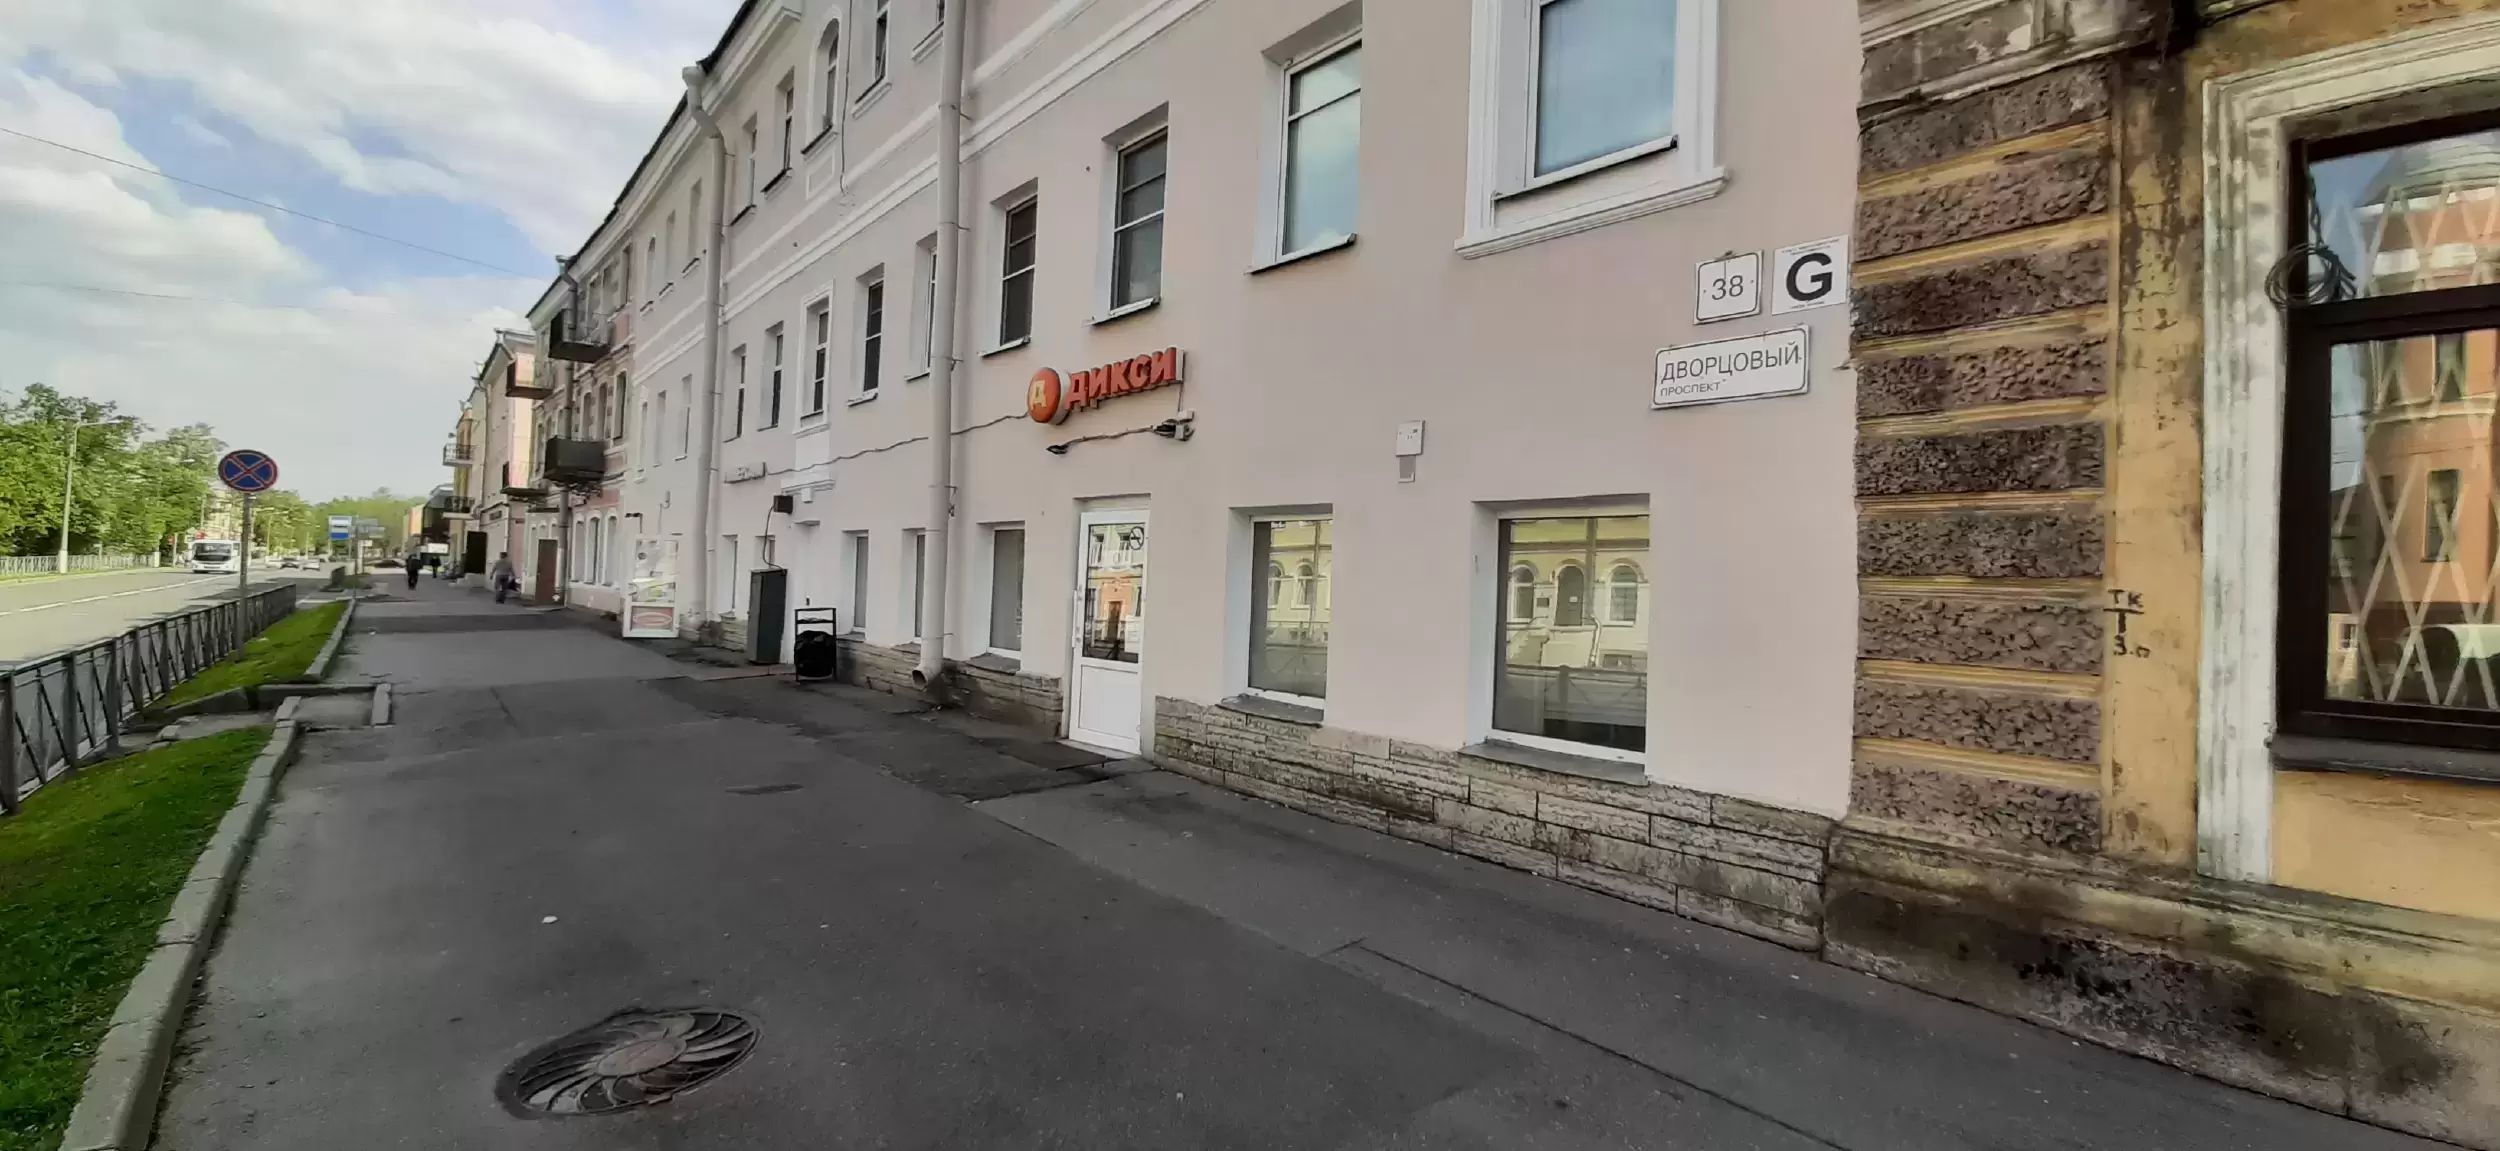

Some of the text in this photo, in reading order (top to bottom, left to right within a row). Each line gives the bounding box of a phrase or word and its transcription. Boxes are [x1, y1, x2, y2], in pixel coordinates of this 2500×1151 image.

[1711, 275, 1744, 301] 38
[1786, 252, 1833, 302] G
[1064, 346, 1181, 411] ДИКСИ
[1660, 341, 1800, 384] ДВОРЦОВЫЙ
[1660, 381, 1721, 397] ПРОСПЕКТ
